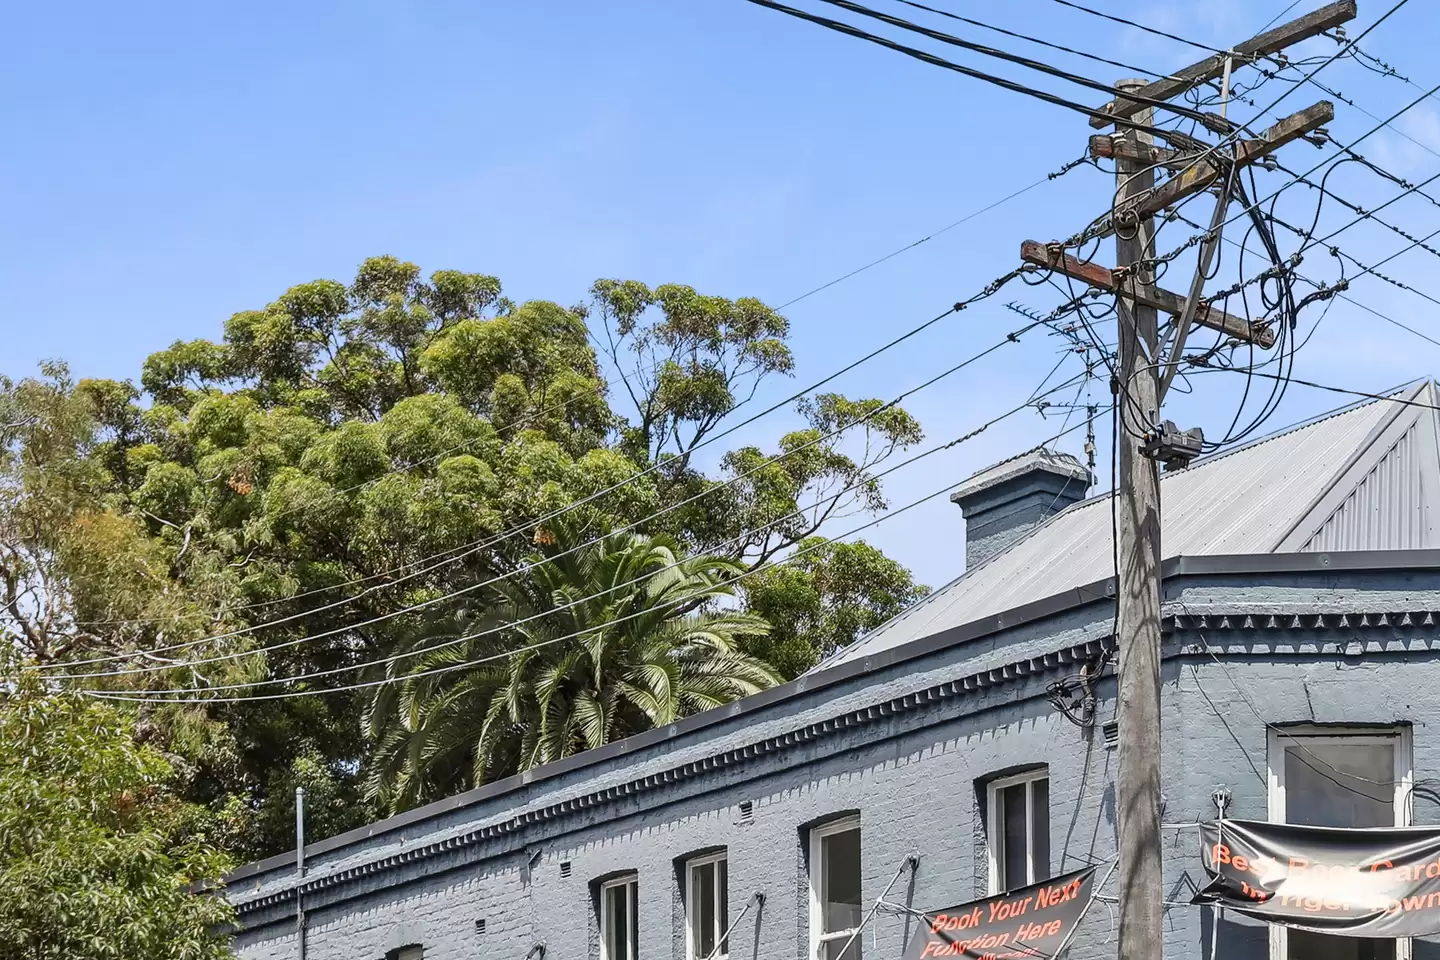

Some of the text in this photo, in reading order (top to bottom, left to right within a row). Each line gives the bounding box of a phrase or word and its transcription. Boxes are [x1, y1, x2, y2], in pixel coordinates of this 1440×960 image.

[930, 880, 1082, 934] Book Your Next
[919, 918, 1063, 960] Function Here
